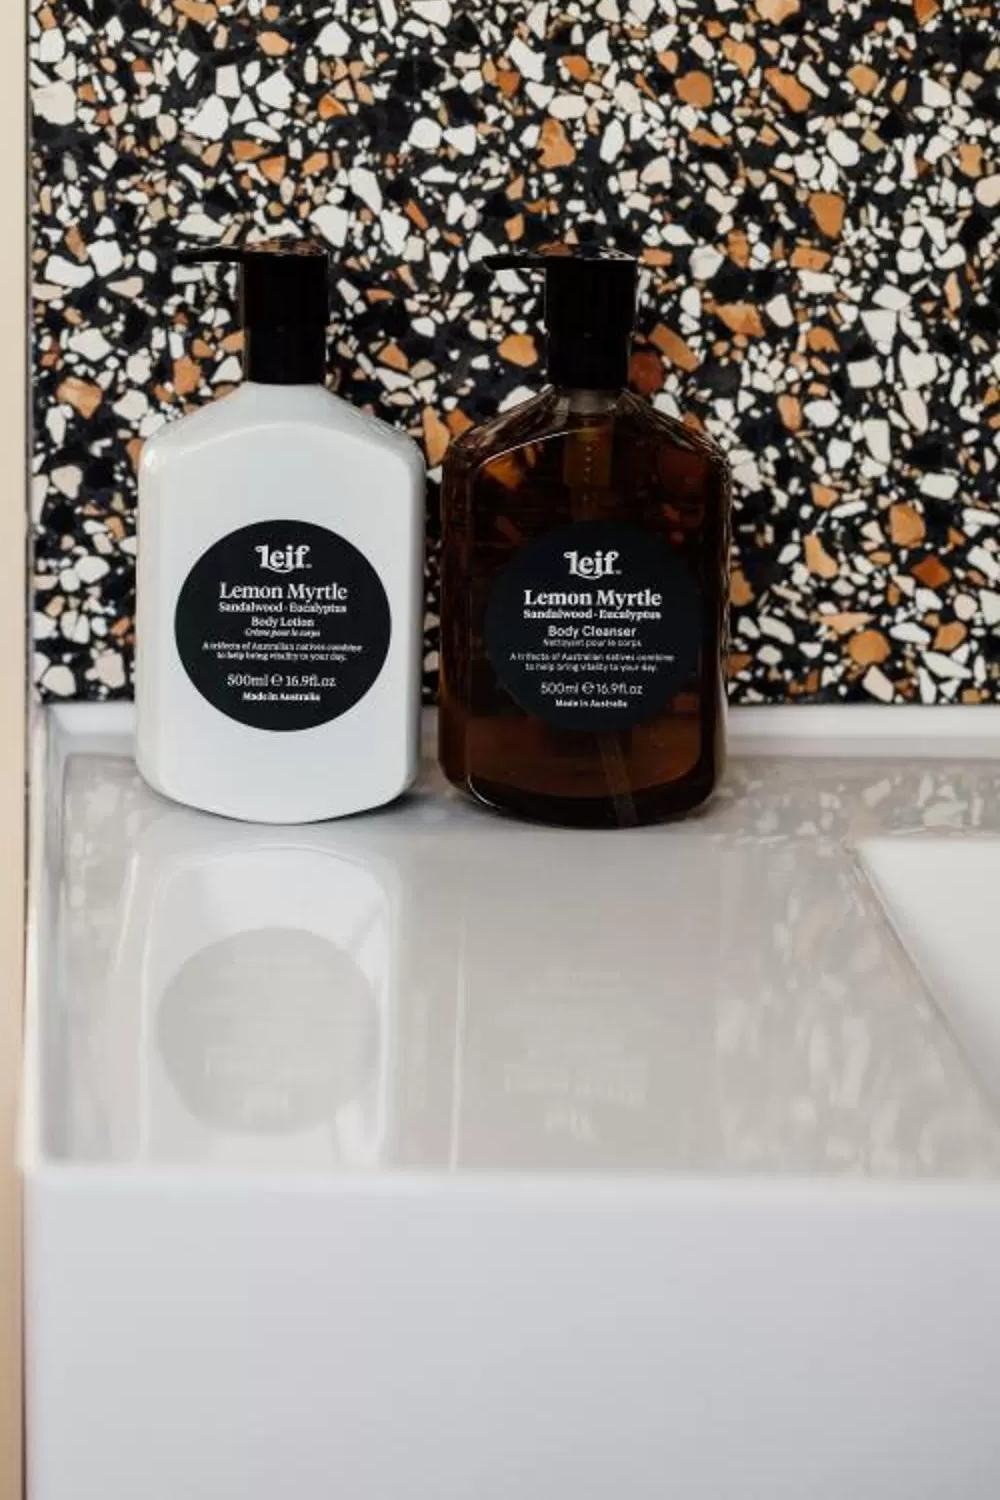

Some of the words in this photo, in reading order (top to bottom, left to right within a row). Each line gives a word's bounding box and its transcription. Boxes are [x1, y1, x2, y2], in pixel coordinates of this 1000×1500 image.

[219, 582, 283, 599] Lemon
[287, 582, 349, 604] Myrtle
[523, 589, 592, 607] Lemon
[596, 588, 662, 610] Myrtle
[218, 602, 283, 613] Sandalwood
[289, 602, 347, 615] Eucalyptus
[523, 608, 592, 619] Sandalwood
[599, 609, 662, 622] Eucalyptus
[251, 616, 278, 629] Body
[280, 616, 315, 627] Lotion
[548, 625, 579, 639] Body
[581, 625, 637, 637] Cleanser
[509, 652, 517, 661] A
[226, 673, 269, 687] 500ml
[541, 682, 579, 695] 500ml
[243, 691, 266, 701] Made
[267, 691, 278, 701] in
[280, 691, 321, 701] Australia
[555, 699, 578, 708] Made
[579, 699, 589, 708] in
[590, 699, 628, 708] Australia
